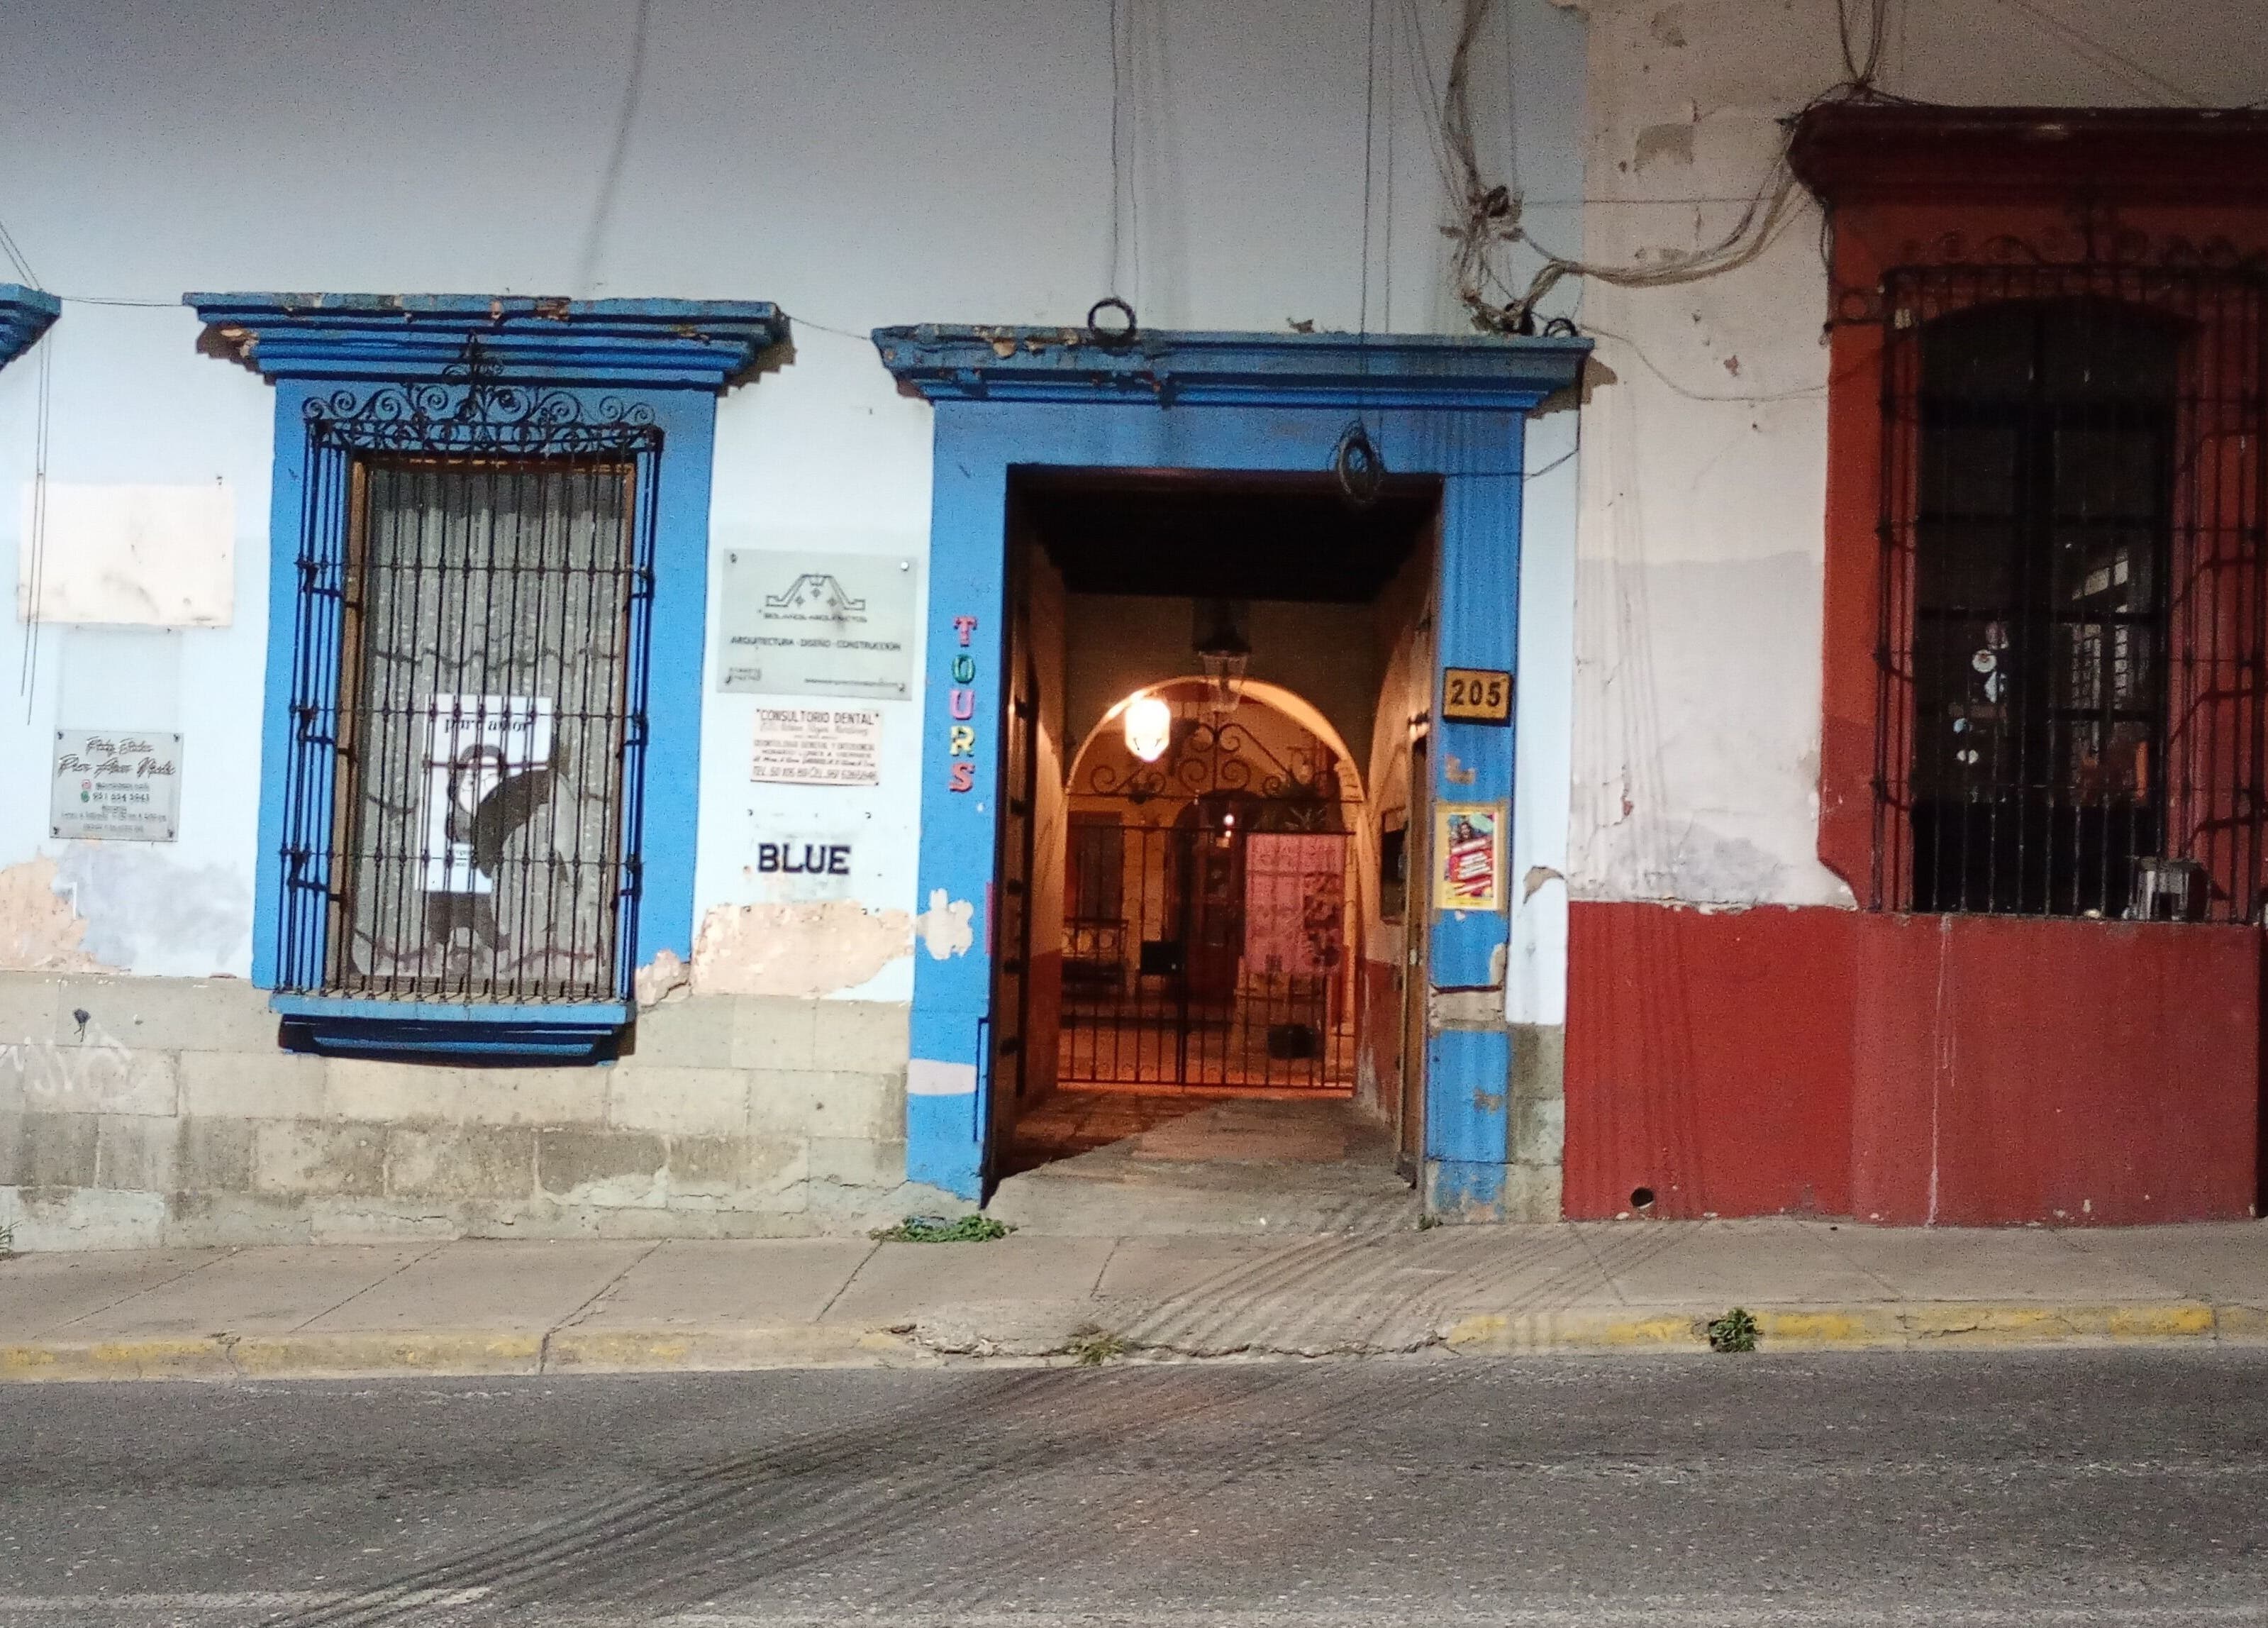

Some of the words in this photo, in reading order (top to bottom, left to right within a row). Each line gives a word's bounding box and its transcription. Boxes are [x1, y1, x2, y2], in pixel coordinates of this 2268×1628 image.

[949, 616, 978, 793] TOURS
[1450, 679, 1502, 708] 205
[760, 709, 830, 724] CONSULTORIO
[835, 711, 874, 726] DENTAL
[758, 843, 852, 875] BLUE
